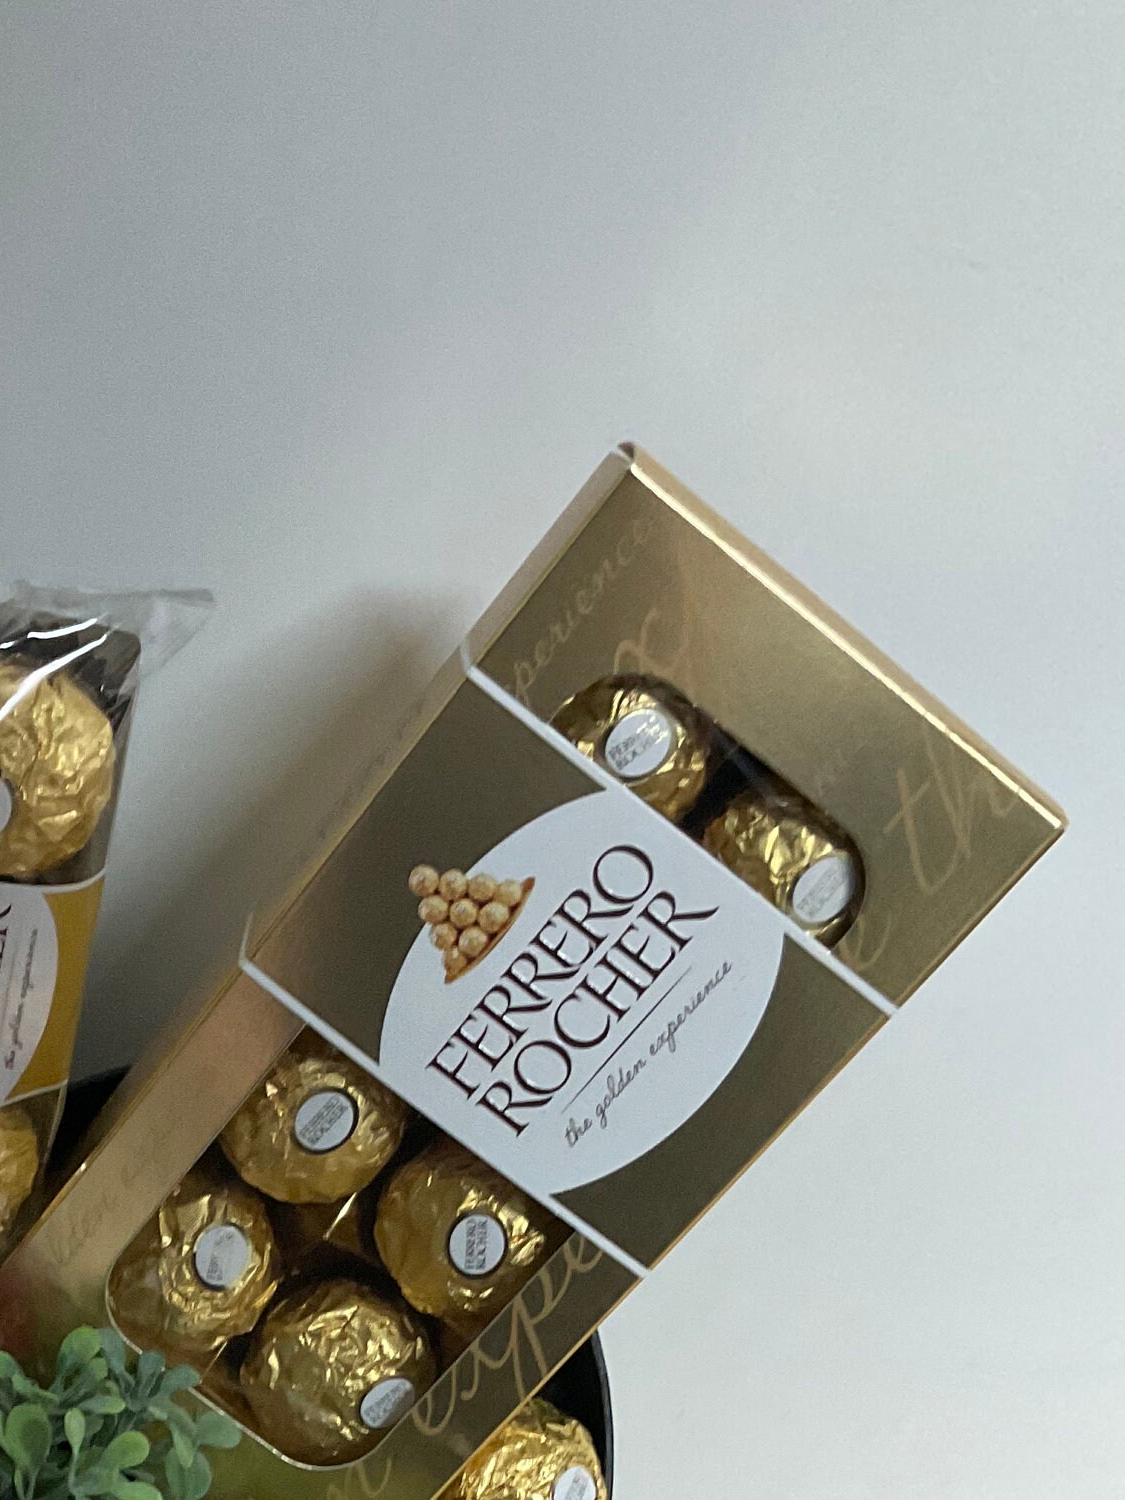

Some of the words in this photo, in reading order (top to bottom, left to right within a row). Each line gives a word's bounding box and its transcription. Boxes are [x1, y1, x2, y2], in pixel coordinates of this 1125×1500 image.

[425, 844, 654, 1101] FERRERO
[475, 890, 720, 1138] ROCHER
[564, 1116, 593, 1149] the
[595, 1057, 647, 1128] golden
[649, 960, 733, 1053] experience
